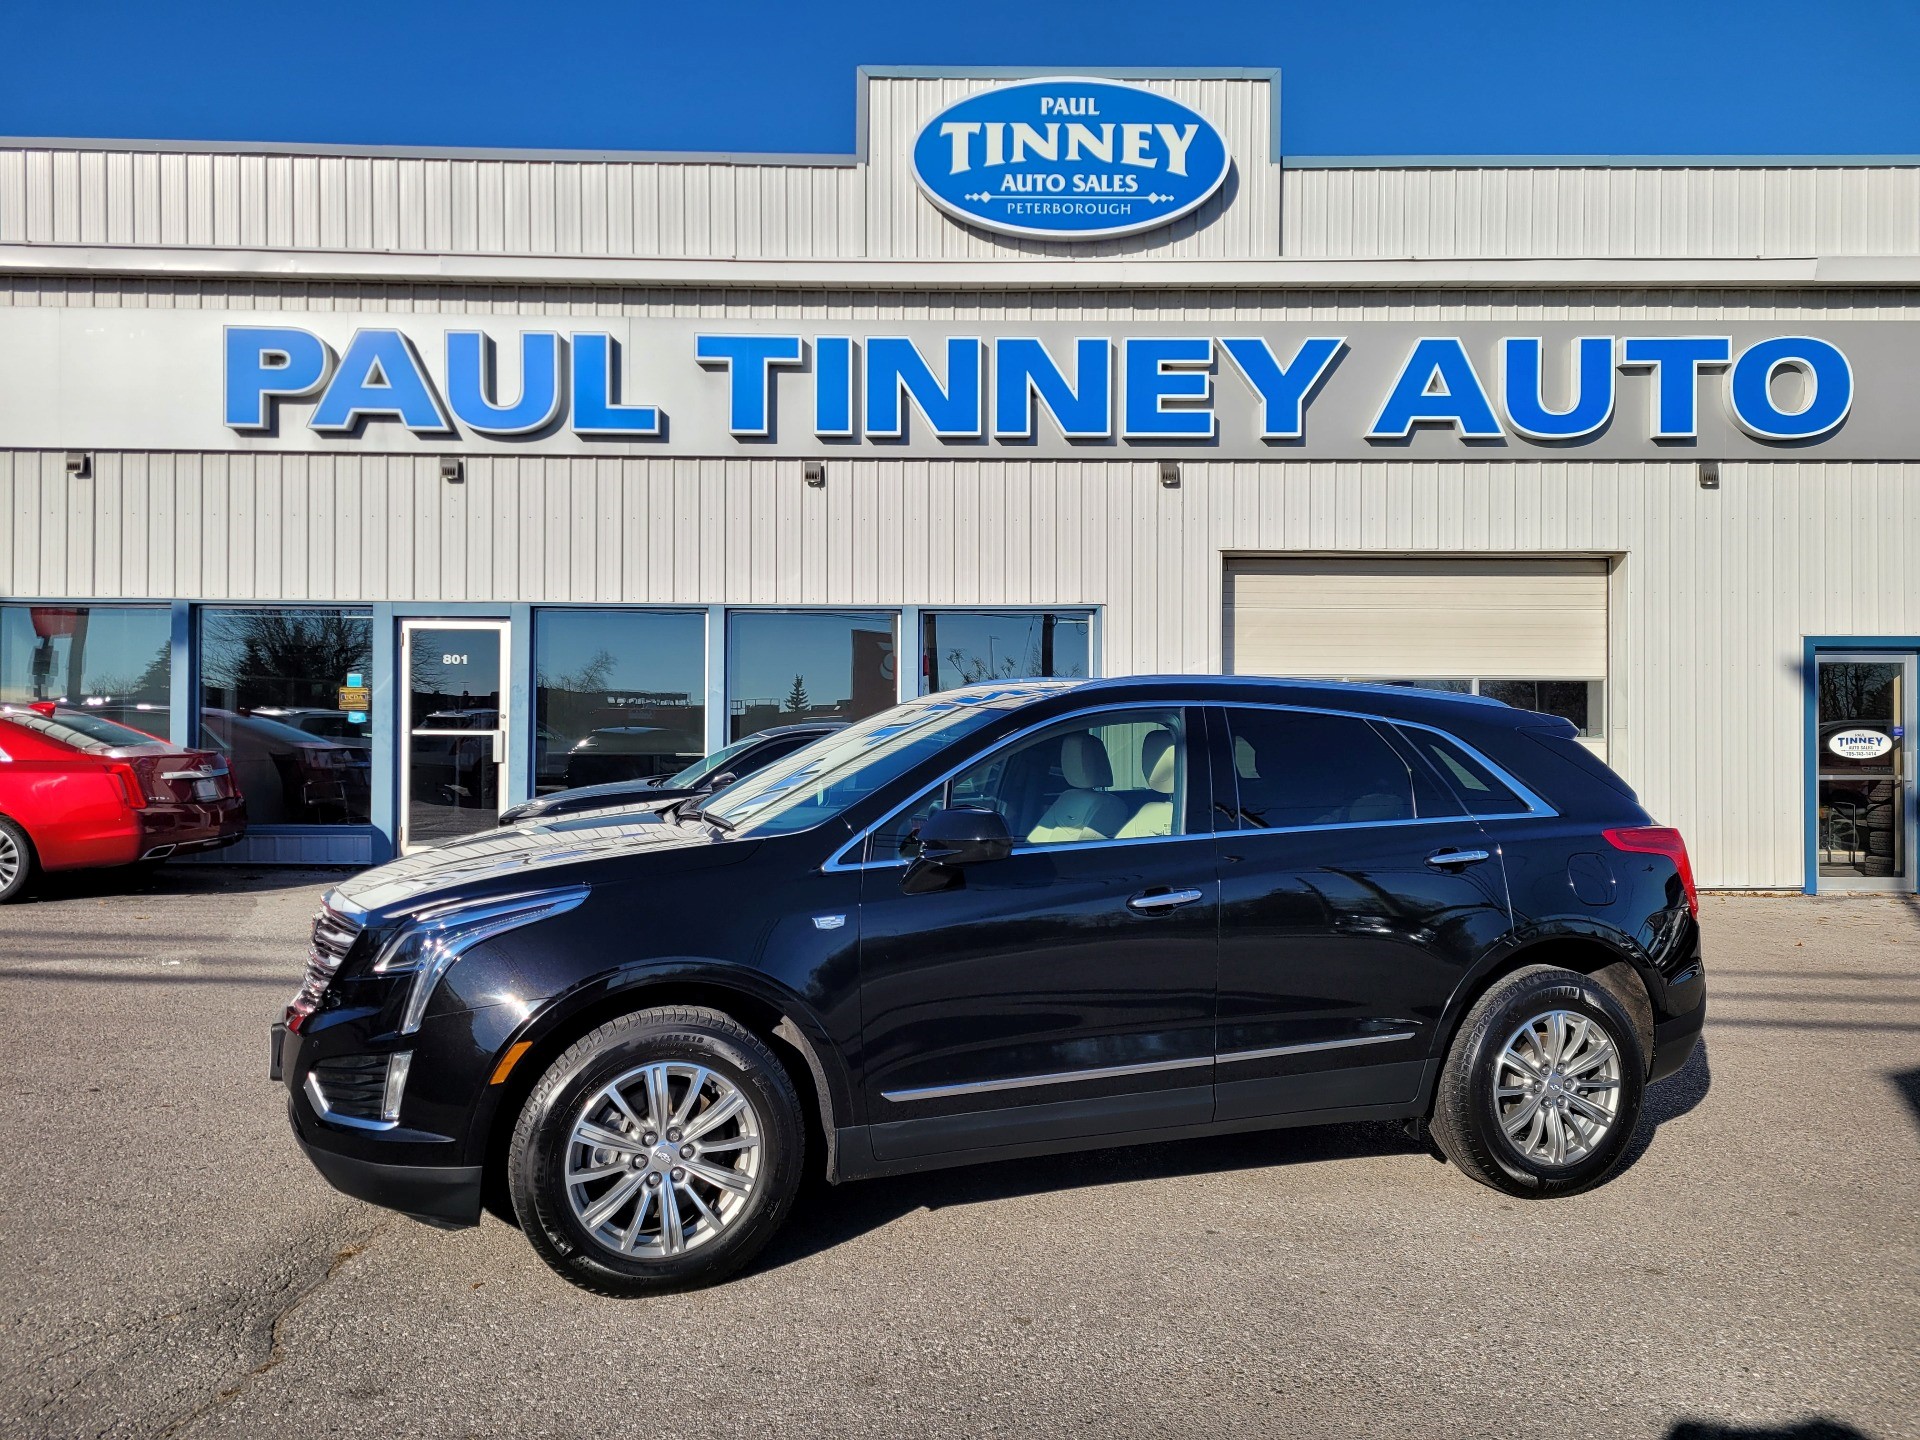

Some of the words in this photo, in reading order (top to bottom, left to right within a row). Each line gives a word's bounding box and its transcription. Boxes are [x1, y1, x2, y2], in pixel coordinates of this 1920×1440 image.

[1040, 97, 1101, 116] PAUL
[939, 122, 1200, 177] TINNEY
[1000, 174, 1066, 192] AUTO
[1072, 174, 1139, 193] SALES
[1006, 202, 1132, 216] PETERBOROUGH
[223, 325, 667, 439] PAUL
[696, 333, 1349, 442] TINNEY
[1366, 334, 1854, 442] AUTO
[442, 654, 468, 665] 801
[1838, 737, 1883, 747] TINNEY
